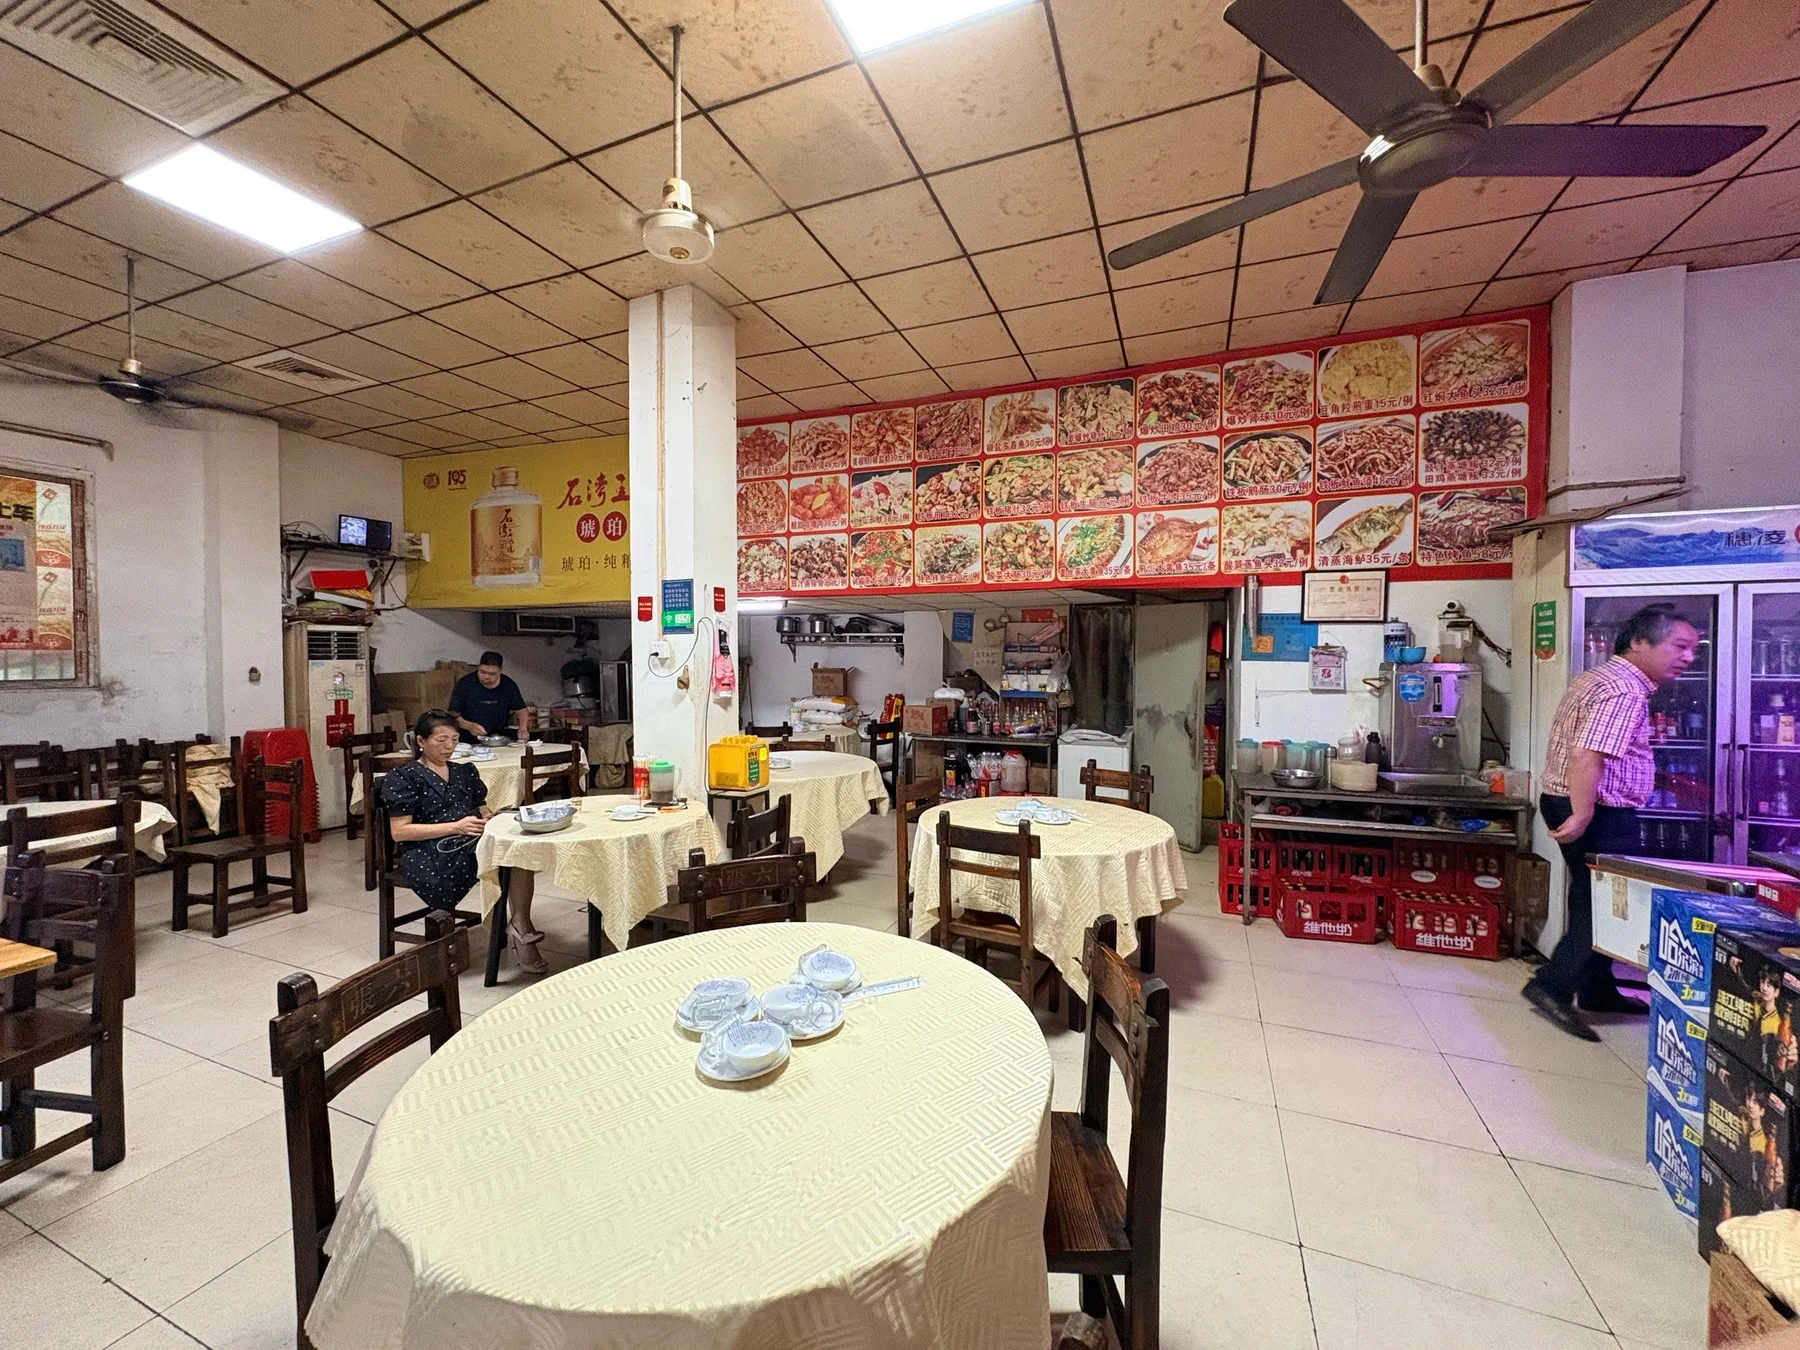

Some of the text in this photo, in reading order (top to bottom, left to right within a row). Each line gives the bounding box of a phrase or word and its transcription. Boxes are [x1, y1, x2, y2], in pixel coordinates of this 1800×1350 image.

[1320, 395, 1413, 415] 豆角粒煎蛋15元/例
[1139, 418, 1218, 435] 爆炒田鸡30元/例
[1139, 489, 1217, 505] 铁板牛肉35元/例
[580, 516, 622, 541] 琥珀
[1318, 552, 1411, 567] 清蒸海鲈35元/条
[1303, 921, 1353, 936] 維他奶
[1415, 932, 1474, 951] 維他奶
